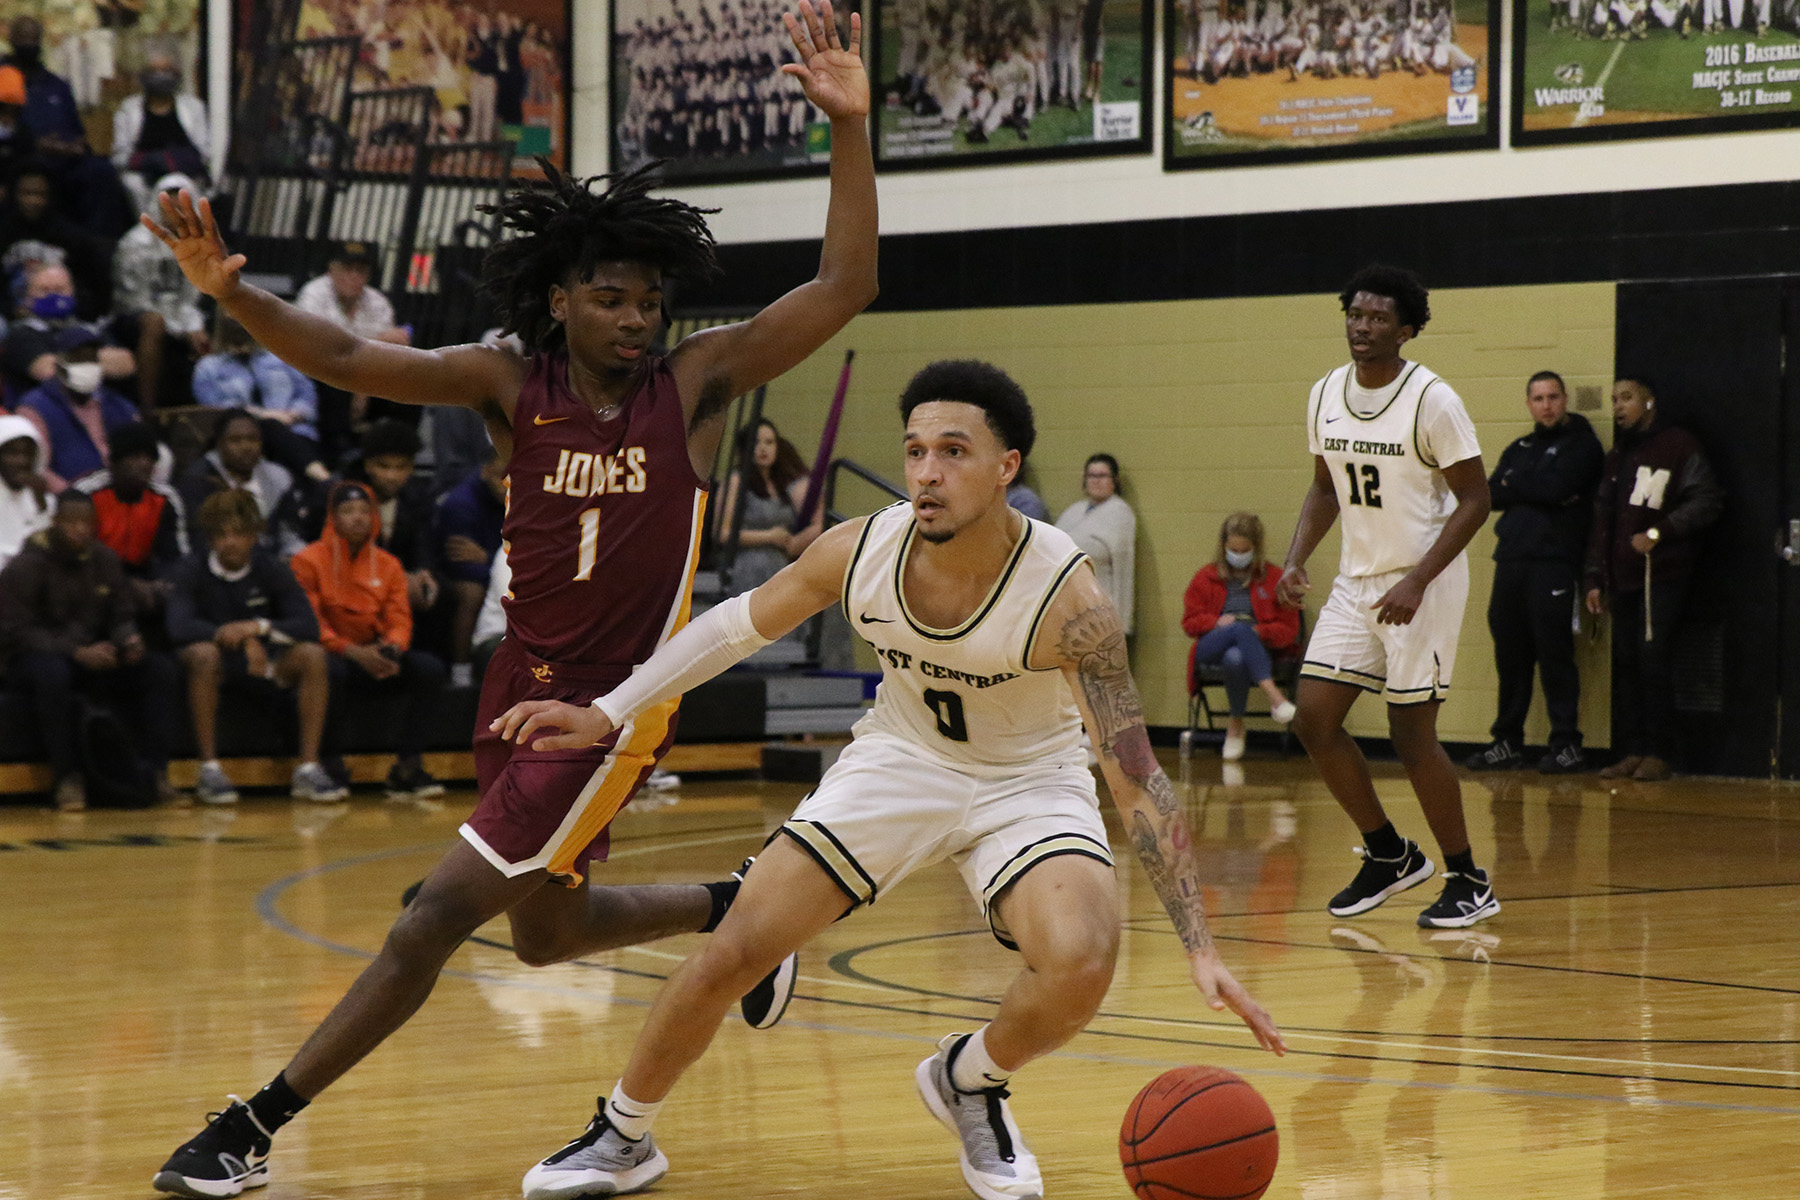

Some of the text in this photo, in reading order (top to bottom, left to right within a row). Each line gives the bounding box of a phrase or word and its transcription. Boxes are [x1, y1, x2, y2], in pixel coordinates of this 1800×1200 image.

[1705, 42, 1800, 67] 2016 BASEBAL
[1534, 86, 1604, 107] WARRIOR
[1692, 69, 1731, 91] MACJC
[1324, 438, 1405, 456] EAST CENTRAL
[543, 446, 647, 498] JONES
[1345, 462, 1383, 509] 12
[1629, 465, 1671, 510] M
[572, 507, 601, 582] 1
[865, 640, 1022, 689] ST CENTRAL
[923, 687, 968, 742] 0
